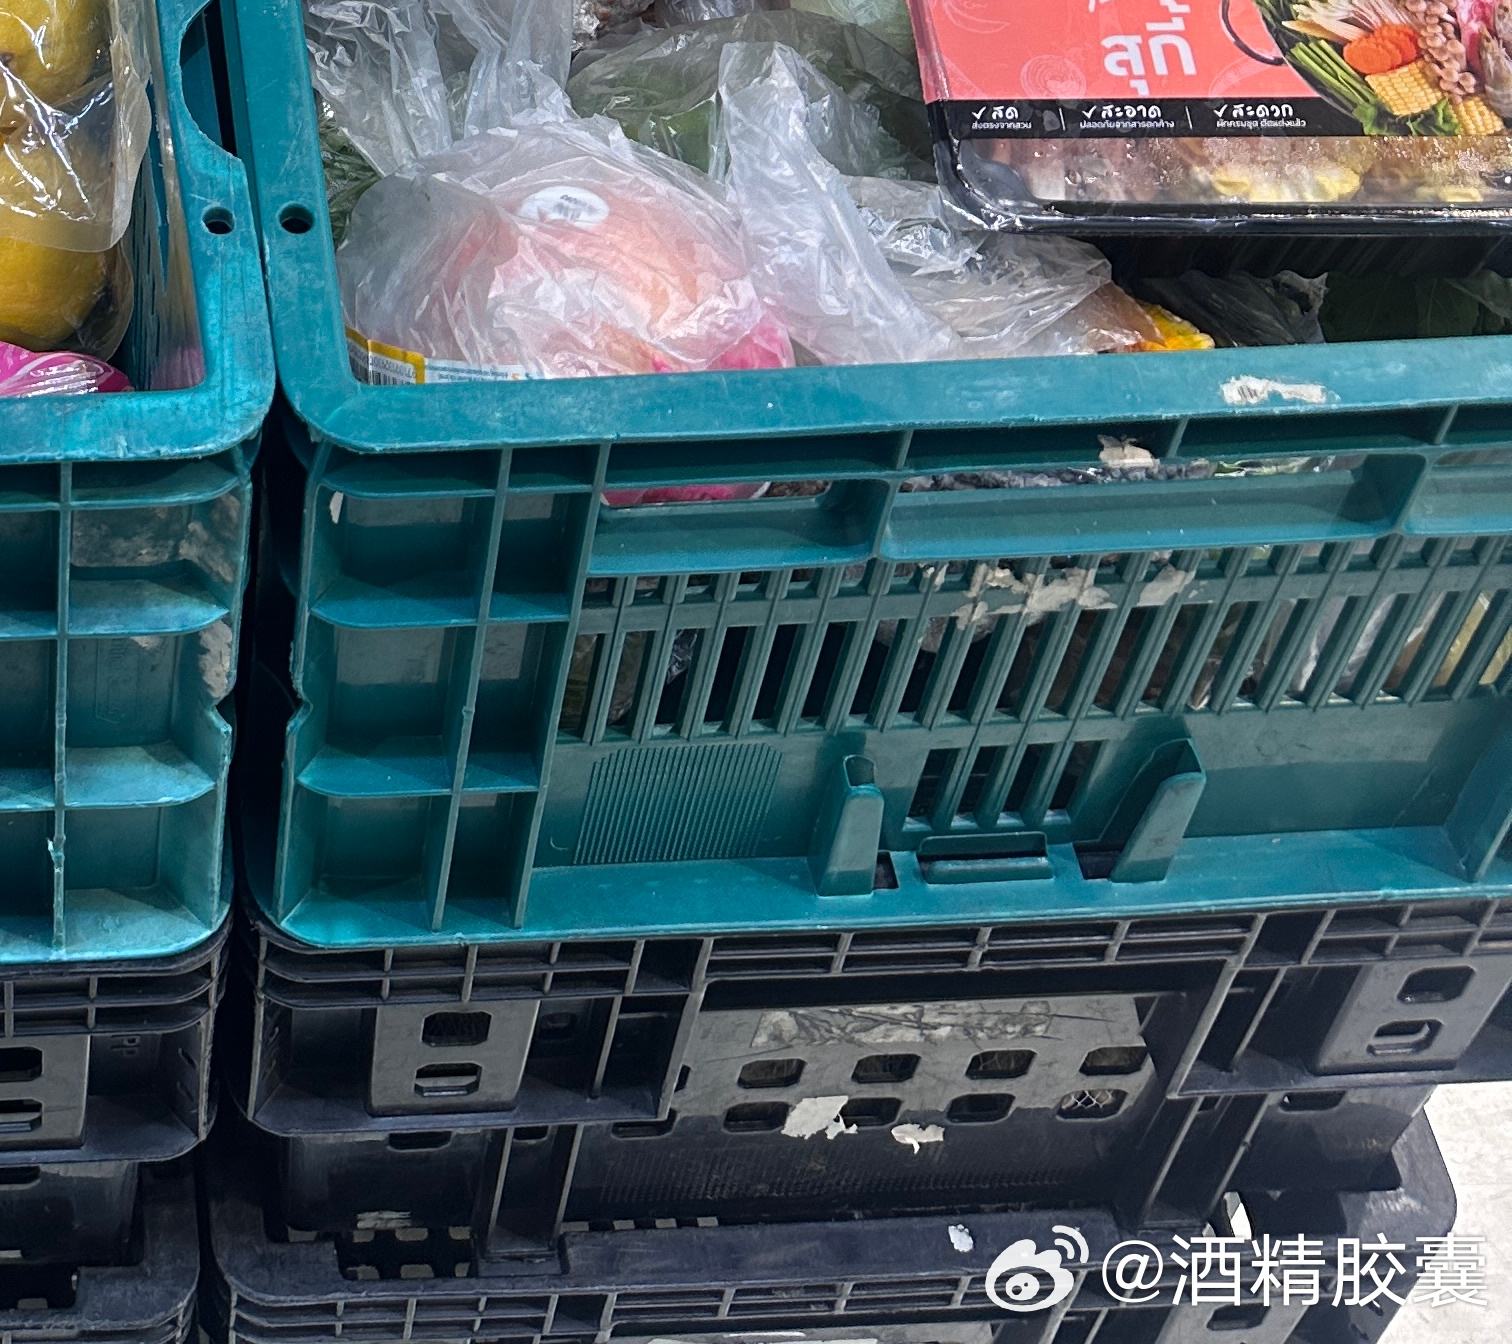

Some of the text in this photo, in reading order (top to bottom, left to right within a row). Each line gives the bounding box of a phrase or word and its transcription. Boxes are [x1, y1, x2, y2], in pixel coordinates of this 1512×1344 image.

[991, 106, 1019, 120] สด
[1101, 105, 1162, 119] สะอาด
[1232, 103, 1294, 118] สะดวก
